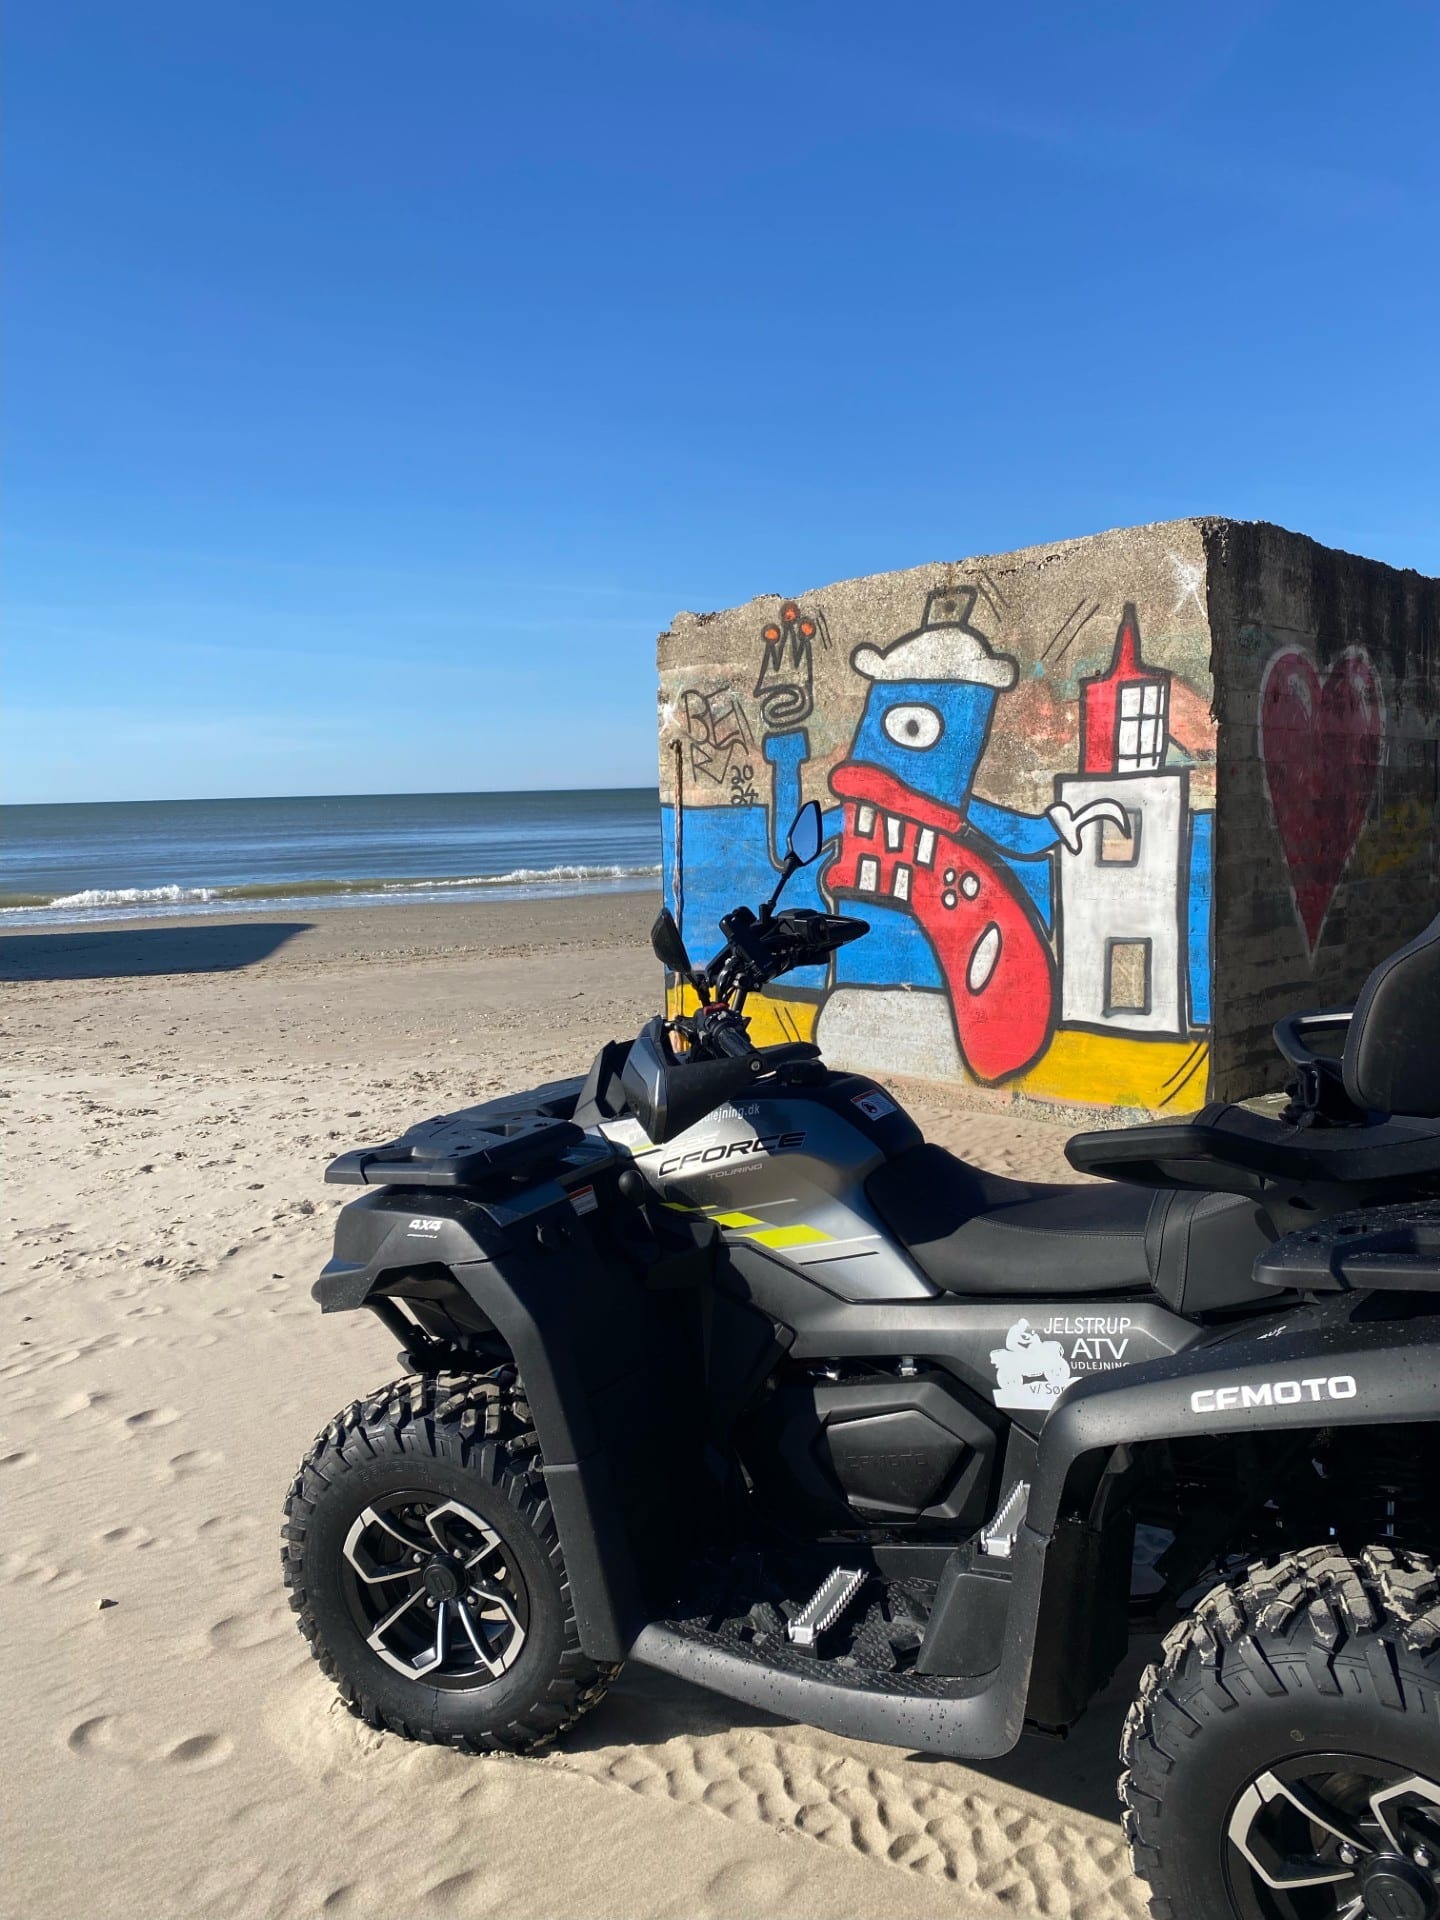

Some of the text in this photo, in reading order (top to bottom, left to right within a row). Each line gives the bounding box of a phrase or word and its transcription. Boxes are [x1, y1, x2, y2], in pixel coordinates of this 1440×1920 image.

[658, 1131, 808, 1177] CFORCE
[708, 1163, 763, 1180] TOURING
[1044, 1317, 1132, 1335] JELSTRUP
[1070, 1338, 1129, 1360] ATV
[1045, 1383, 1066, 1395] Sør
[1191, 1375, 1357, 1413] CFMOTO
